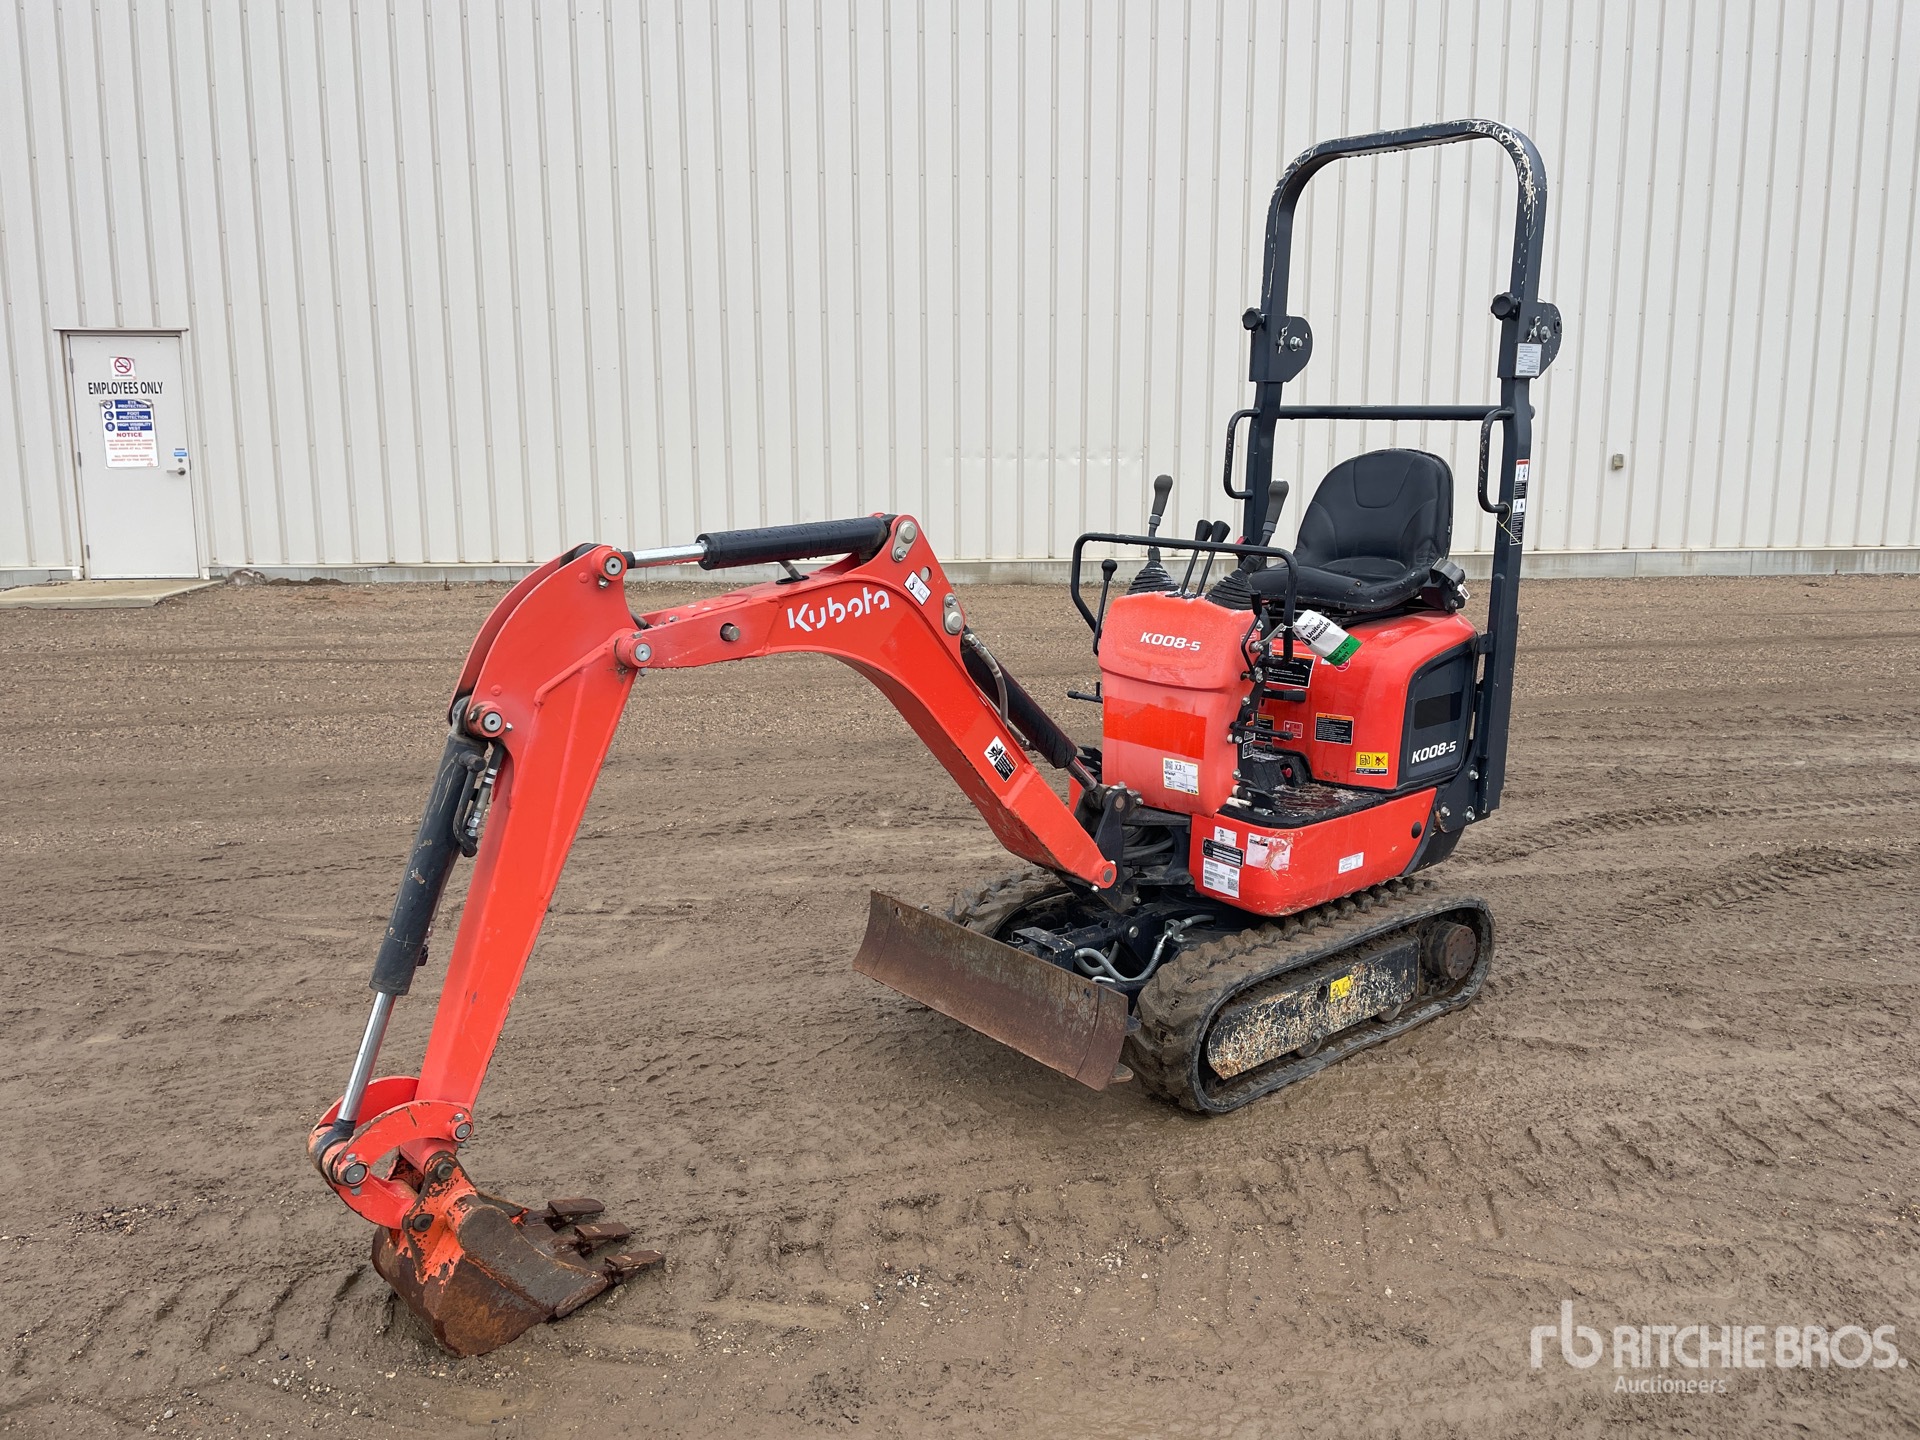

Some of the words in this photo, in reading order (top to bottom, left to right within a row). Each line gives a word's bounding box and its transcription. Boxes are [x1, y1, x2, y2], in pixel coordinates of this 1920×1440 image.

[88, 382, 139, 395] EMPLOYEES
[140, 382, 163, 394] ONLY
[787, 587, 890, 632] Kubota
[1305, 619, 1324, 638] United
[1311, 622, 1330, 641] Rentals
[1140, 632, 1202, 652] K008-5
[1411, 740, 1457, 764] K008-5
